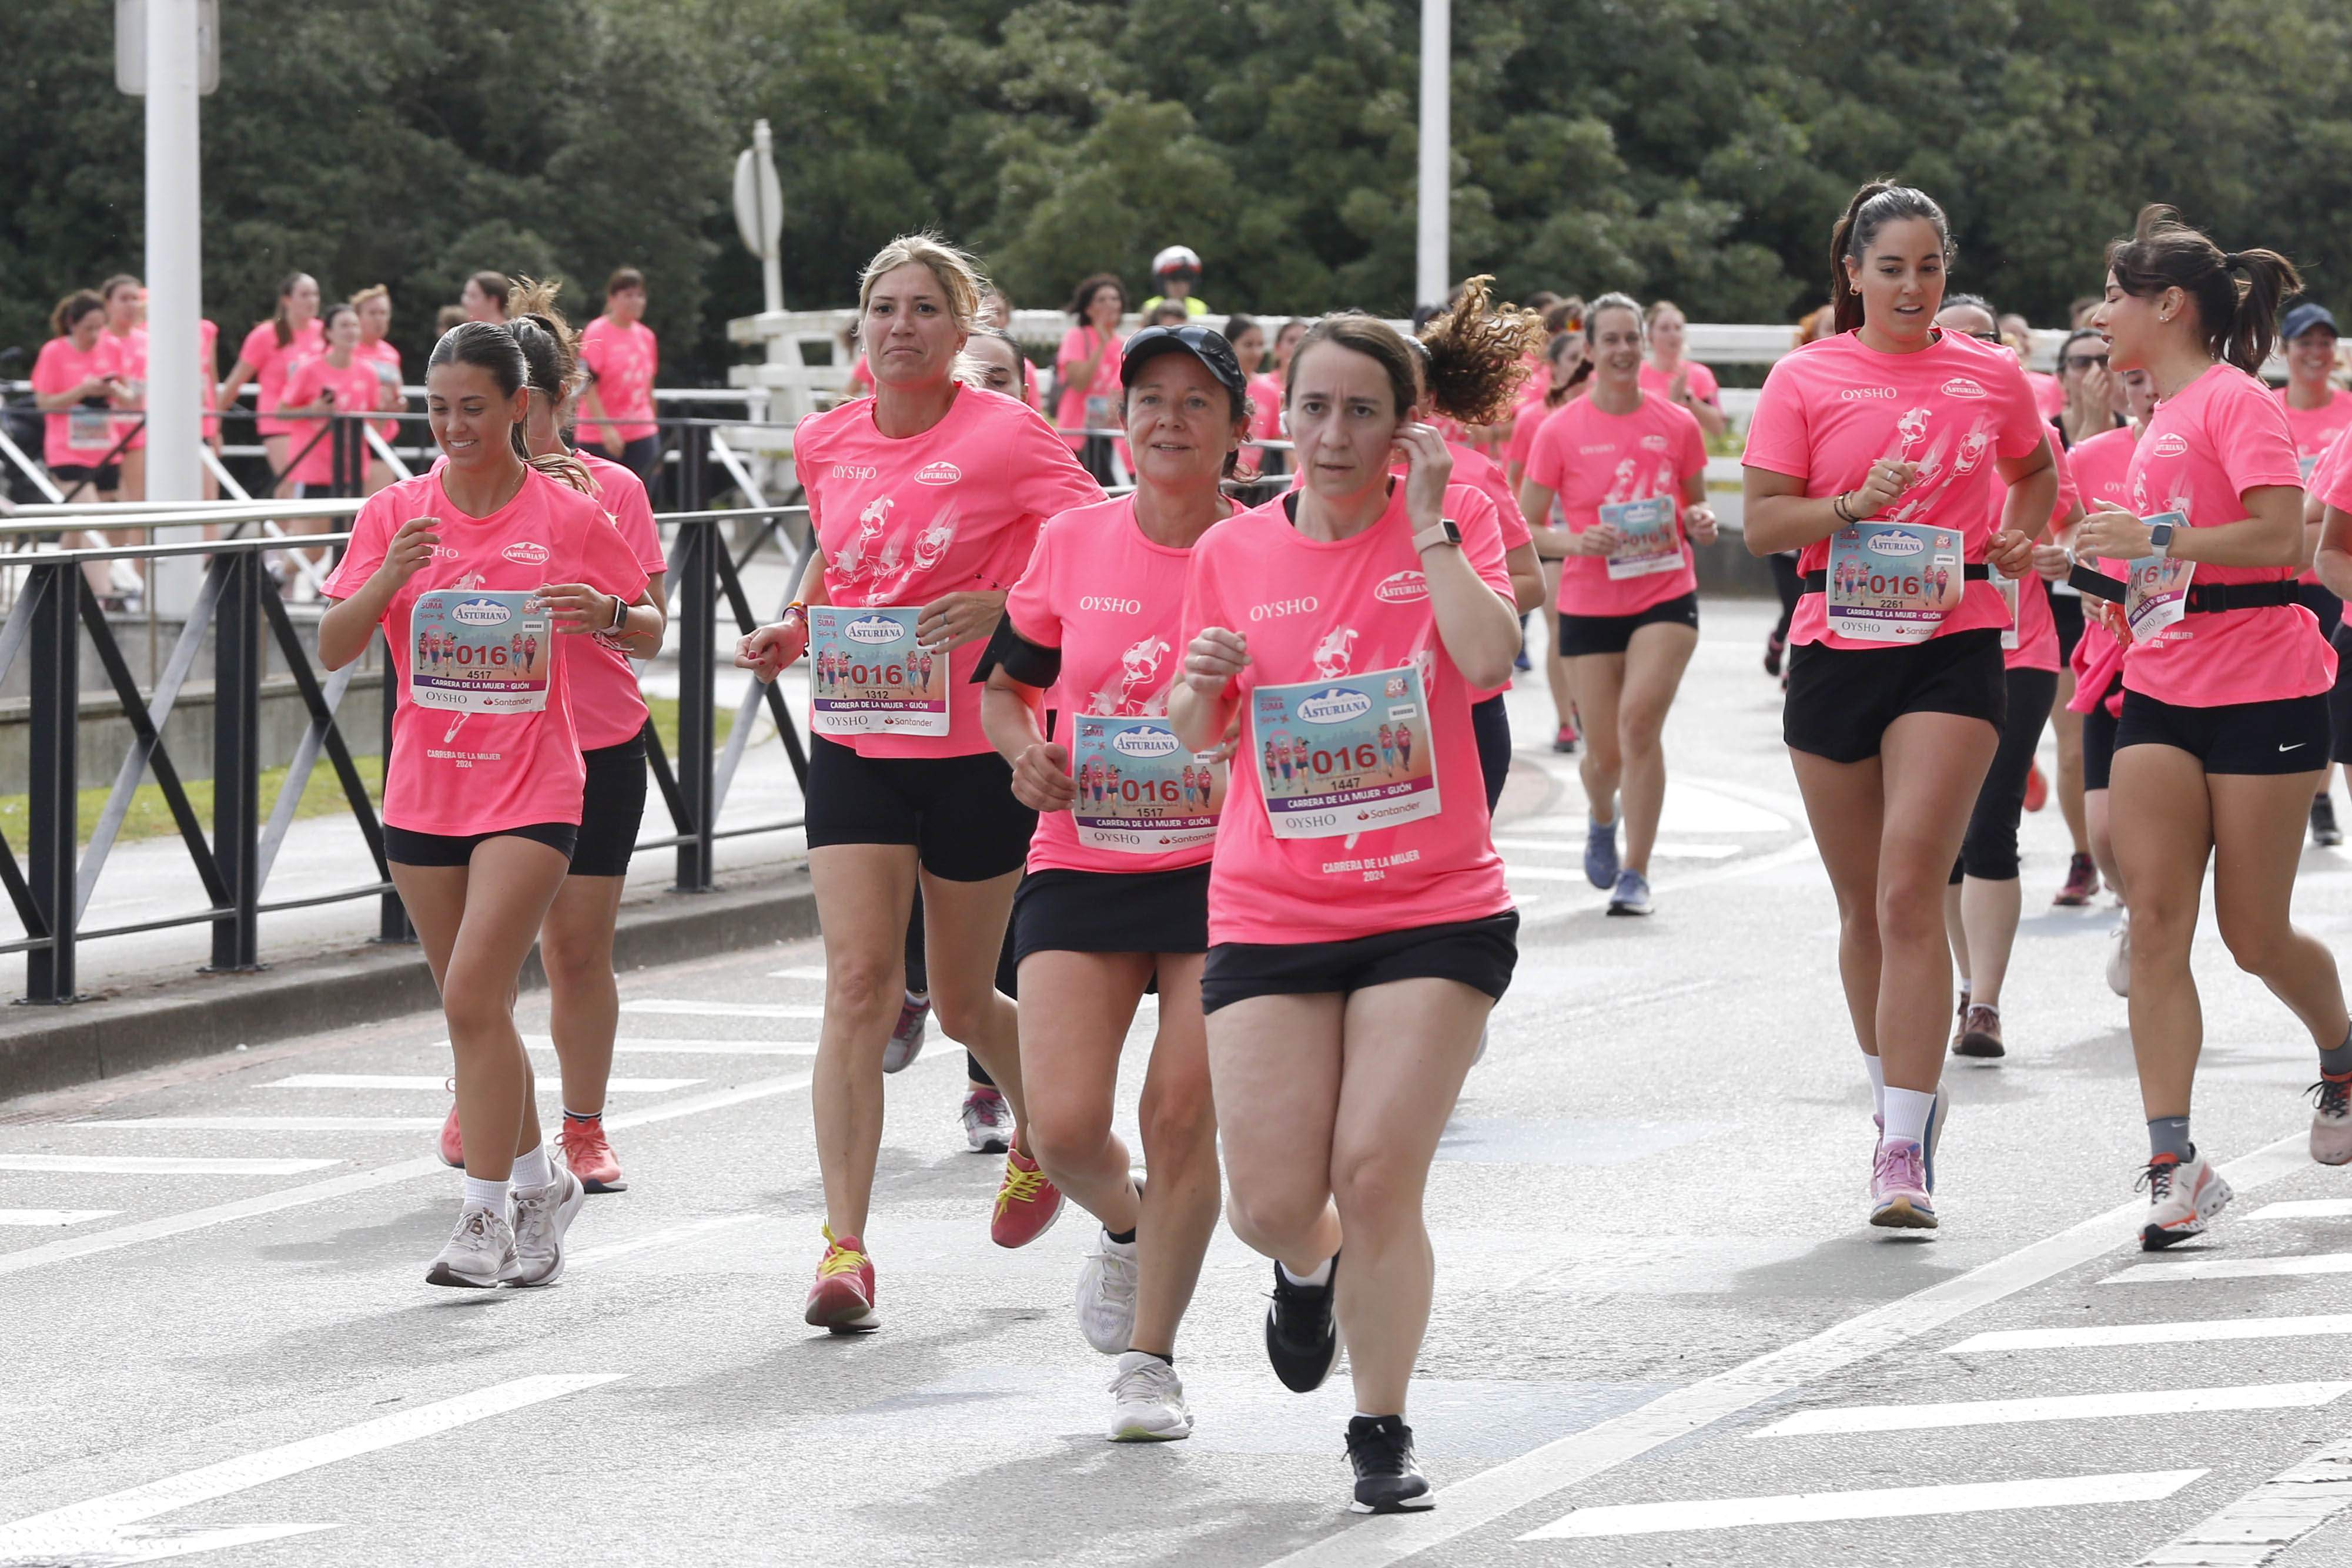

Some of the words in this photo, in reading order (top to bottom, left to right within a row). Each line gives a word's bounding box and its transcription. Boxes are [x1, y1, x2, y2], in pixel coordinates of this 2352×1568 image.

[1841, 386, 1897, 400] OYSHO
[1946, 385, 1985, 396] ASTURIANA
[832, 464, 876, 480] OYSHO
[918, 470, 957, 480] ASTURIANA
[1871, 539, 1921, 551] ASTURIANA
[1380, 584, 1429, 598] ASTURIAN
[1870, 575, 1919, 595] 016
[1079, 595, 1142, 615] OYSHO
[1250, 596, 1319, 622] OYSHO
[1881, 599, 1903, 608] 2261
[455, 608, 508, 620] ASTURIANA
[1846, 608, 1875, 617] CARRERA
[848, 626, 901, 638] ASTURIANA
[1841, 621, 1881, 633] OYSHO
[1906, 626, 1935, 635] Santan
[456, 645, 508, 665] 016
[467, 670, 492, 679] 4517
[851, 664, 902, 685] 016
[431, 678, 460, 688] CARRERA
[511, 681, 530, 690] GIJÓN
[426, 691, 467, 704] OYSHO
[865, 690, 889, 699] 1312
[494, 697, 533, 706] Santander
[909, 701, 928, 709] GIJÓN
[1302, 701, 1368, 719] ASTURIANA
[827, 715, 868, 726] OYSHO
[895, 718, 933, 727] Santander
[1116, 736, 1175, 751] ASTURIANA
[427, 749, 457, 759] CARRERA
[1312, 743, 1377, 775] 016
[456, 759, 473, 768] 2024
[1330, 777, 1361, 791] 1447
[1122, 779, 1179, 802] 016
[1287, 797, 1324, 809] CARRERA
[1326, 796, 1337, 805] DE
[1339, 793, 1350, 802] LA
[1352, 789, 1381, 800] MUJER
[1387, 782, 1411, 795] GIJÓN
[1136, 808, 1164, 817] 1517
[1370, 800, 1421, 819] Santander
[1096, 819, 1130, 827] CARRERA
[1156, 819, 1182, 827] MUJER
[1187, 817, 1211, 826] GIJÓN
[1285, 813, 1336, 829] OYSHO
[1094, 832, 1140, 845] OYSHO
[1172, 832, 1216, 844] Santande
[1322, 860, 1363, 873] CARRERA
[1363, 858, 1377, 869] DE
[1377, 856, 1390, 868] LA
[1390, 849, 1420, 866] MUJER
[1363, 870, 1386, 882] 2024
